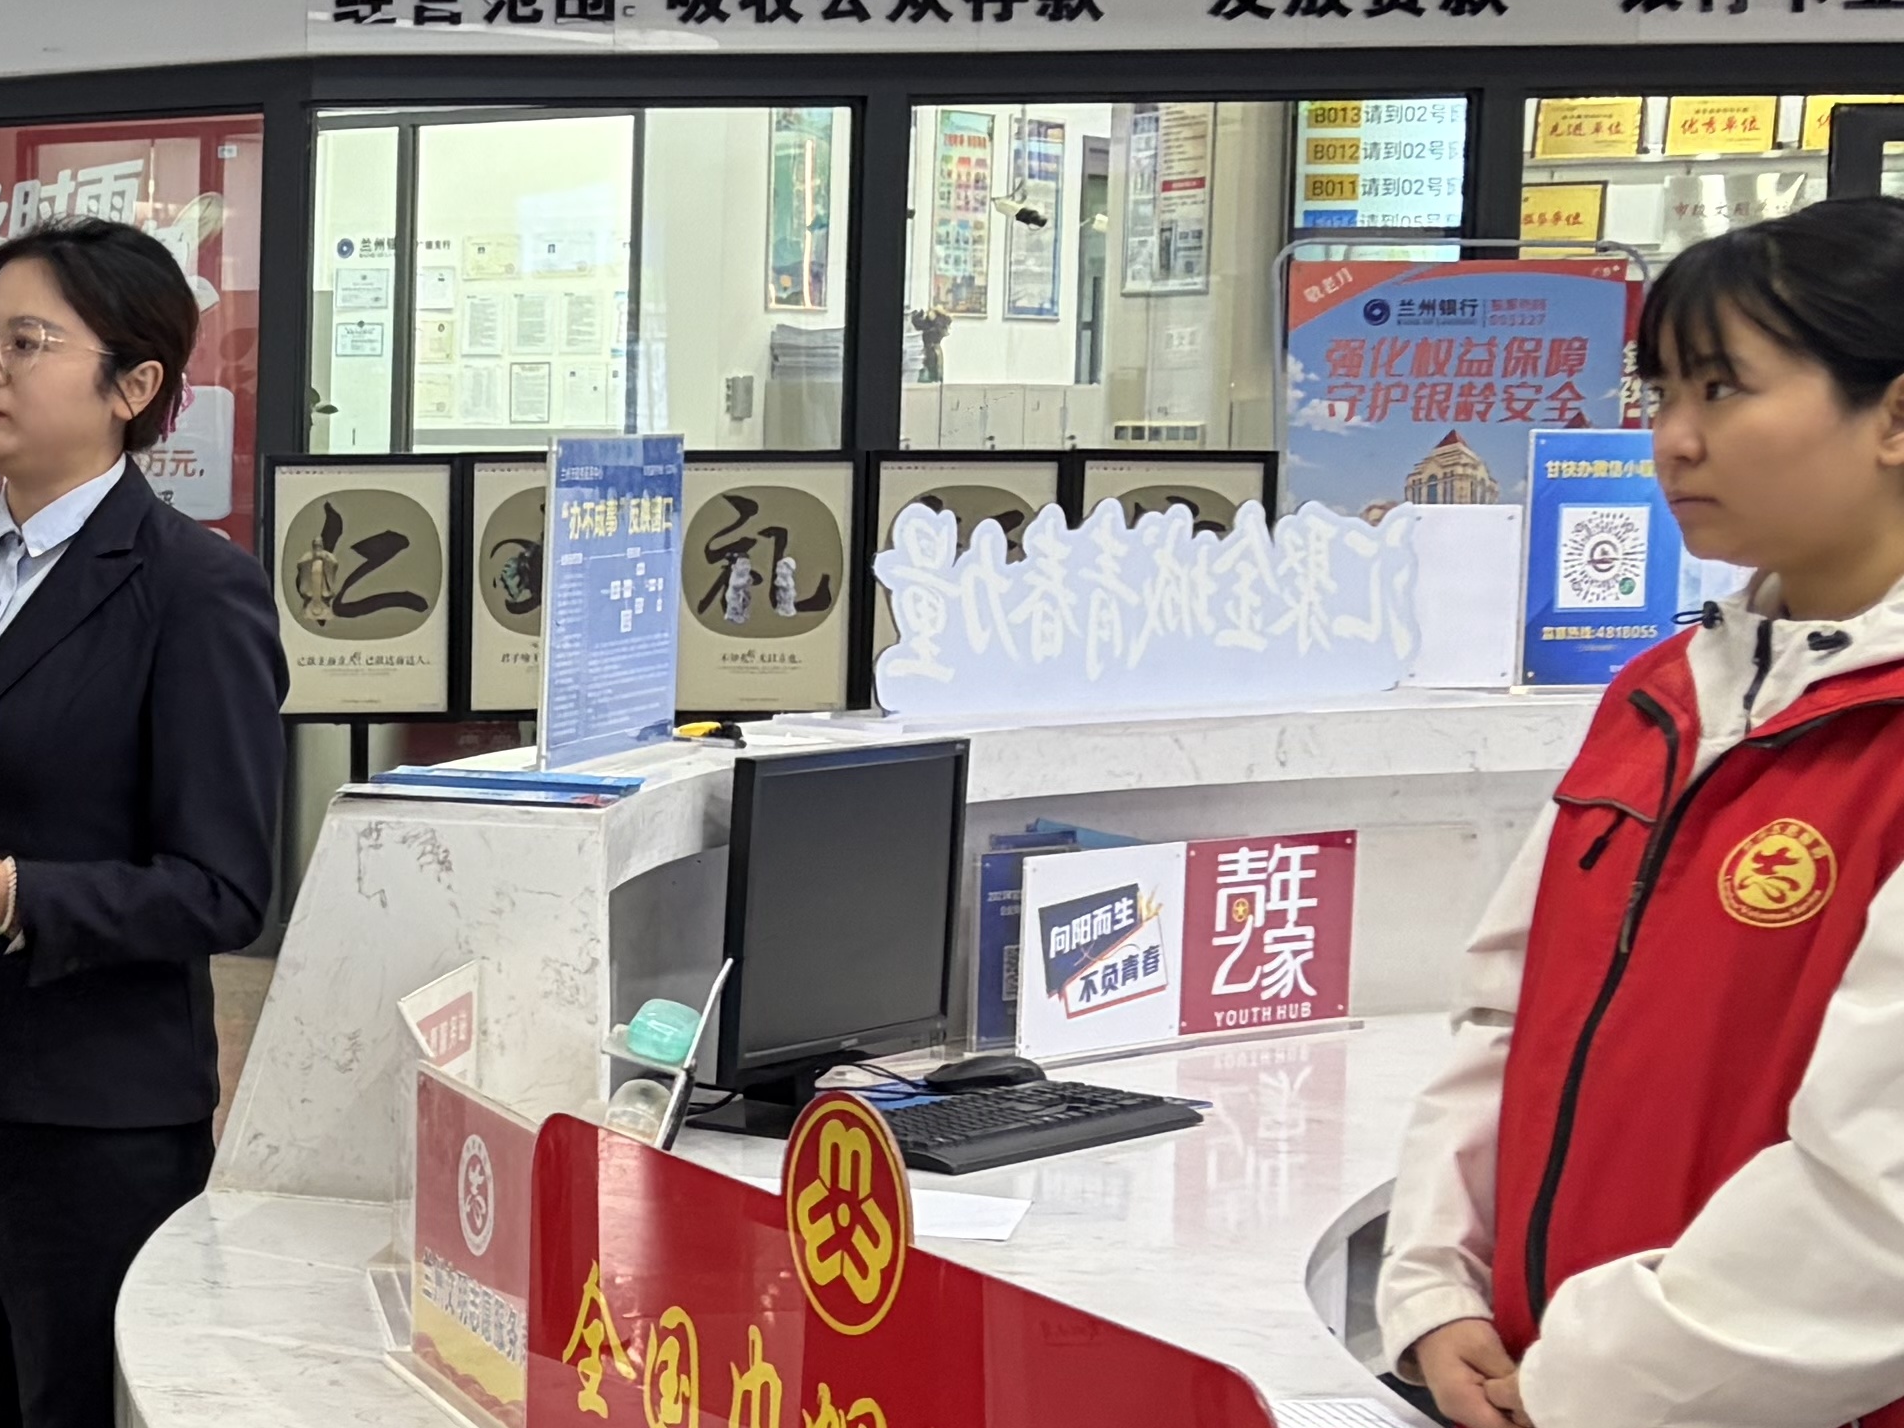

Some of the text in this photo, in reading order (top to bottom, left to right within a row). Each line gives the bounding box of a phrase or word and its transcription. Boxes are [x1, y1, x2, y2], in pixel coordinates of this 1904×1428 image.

[1314, 106, 1362, 123] B013
[1680, 116, 1761, 135] 优秀单位
[1312, 143, 1360, 161] B012
[1312, 179, 1358, 197] B011
[1397, 298, 1479, 318] 兰州银行
[1325, 335, 1590, 380] 强化权益保障
[1325, 380, 1588, 424] 守护银龄安全
[1049, 897, 1136, 959] 向阳而生
[1079, 944, 1161, 1004] 不负青春
[1214, 1002, 1312, 1027] YOUTH HUB
